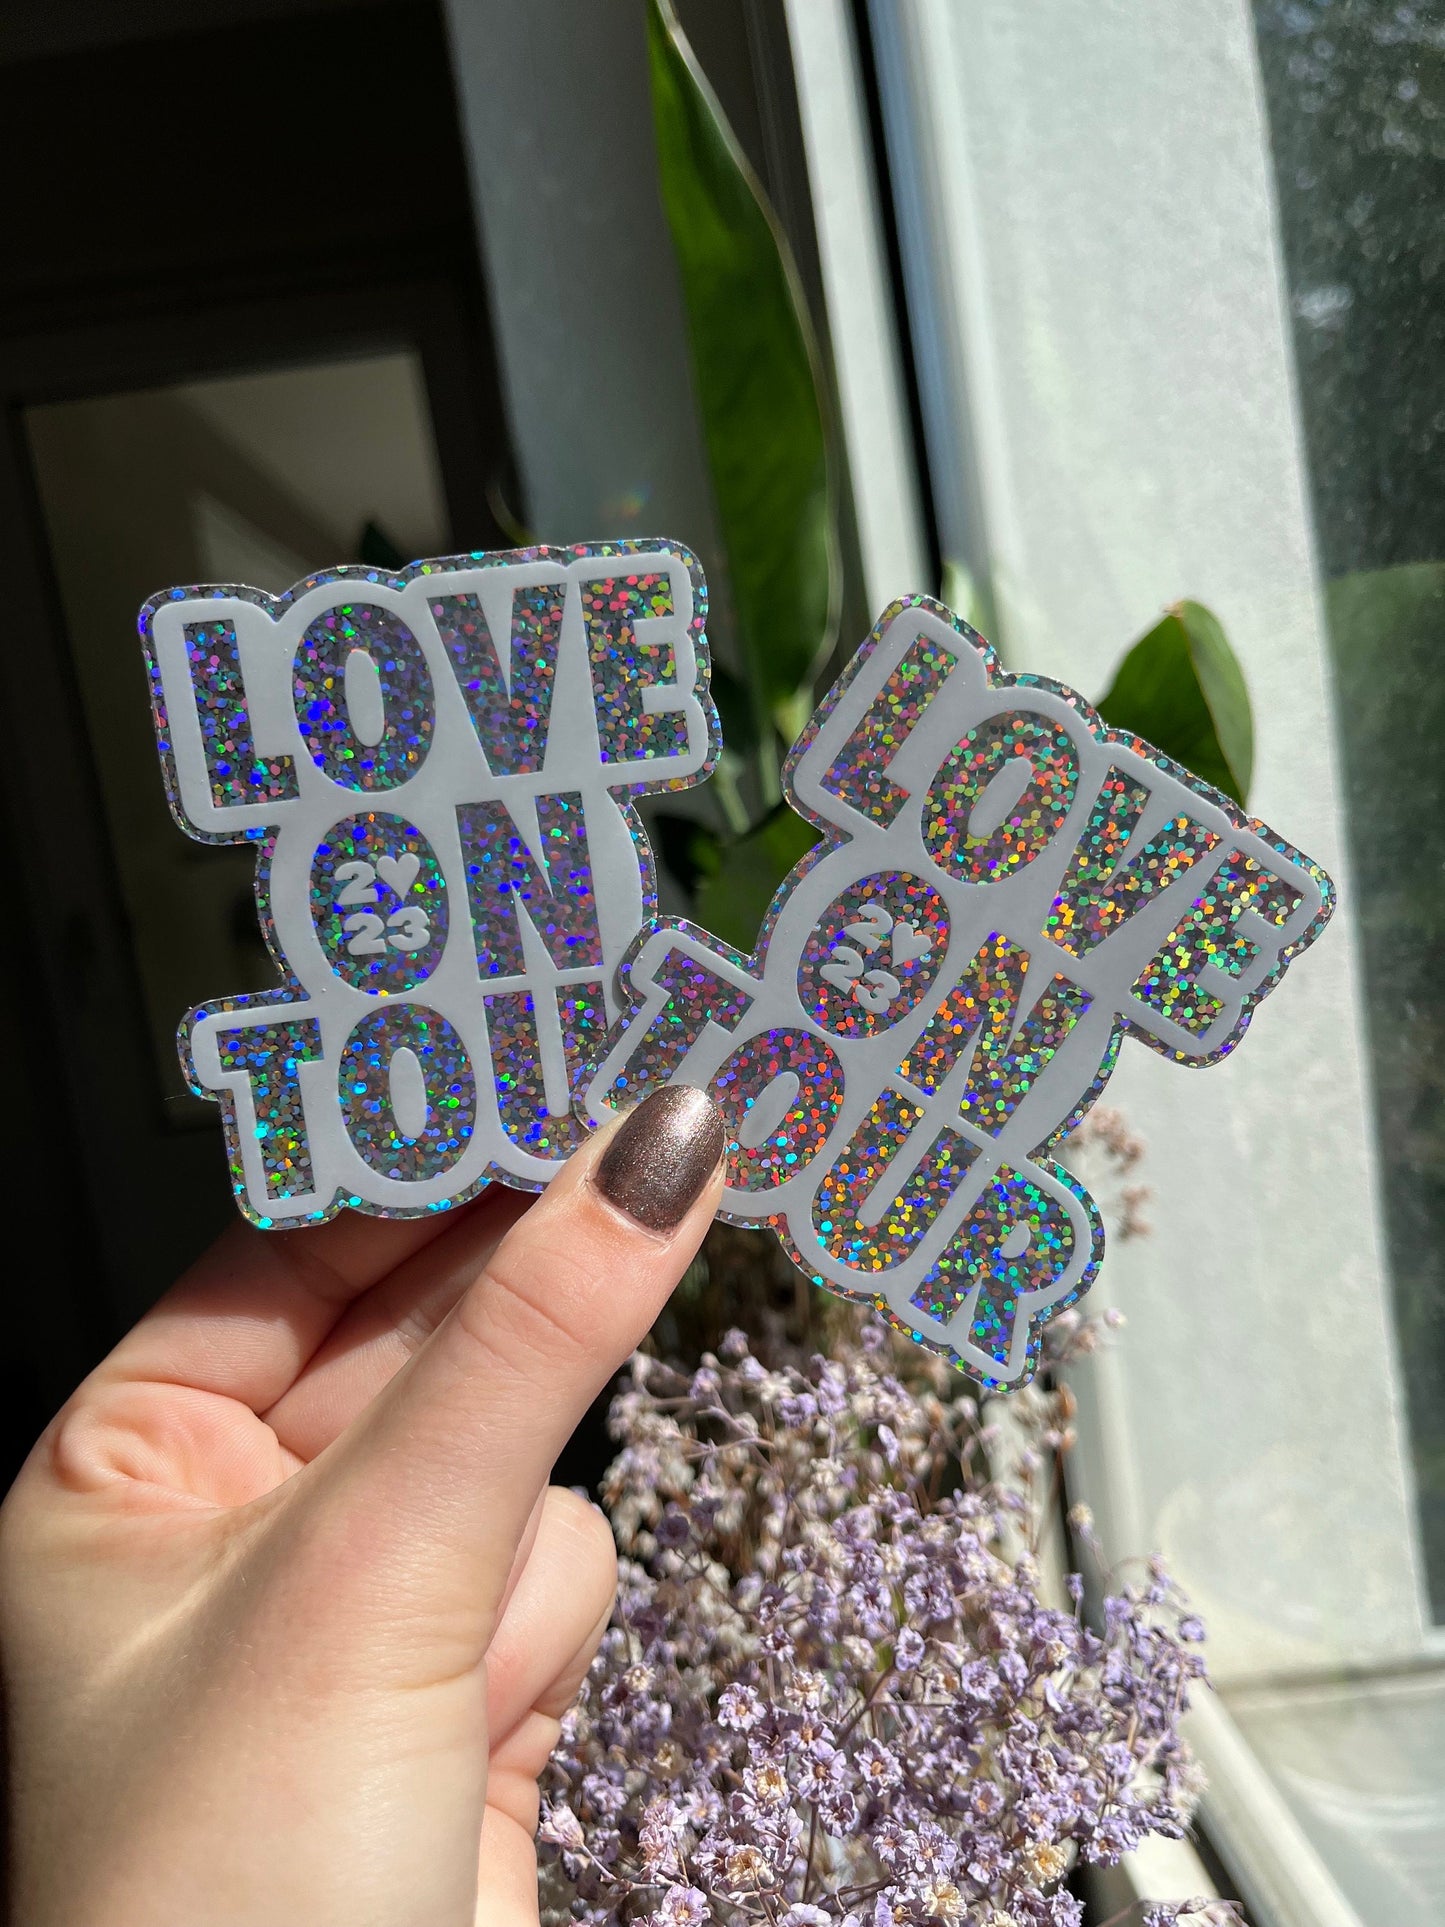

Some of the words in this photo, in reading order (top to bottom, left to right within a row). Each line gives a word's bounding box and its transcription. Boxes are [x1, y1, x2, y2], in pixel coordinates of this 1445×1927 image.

[182, 571, 690, 808] LOVE
[309, 791, 604, 996] ON
[343, 906, 431, 956] 23
[819, 631, 1307, 1037] LOVE
[215, 980, 609, 1201] TOU
[797, 870, 1093, 1138] ON
[820, 946, 901, 1013] 23
[600, 946, 1076, 1366] TOUR
